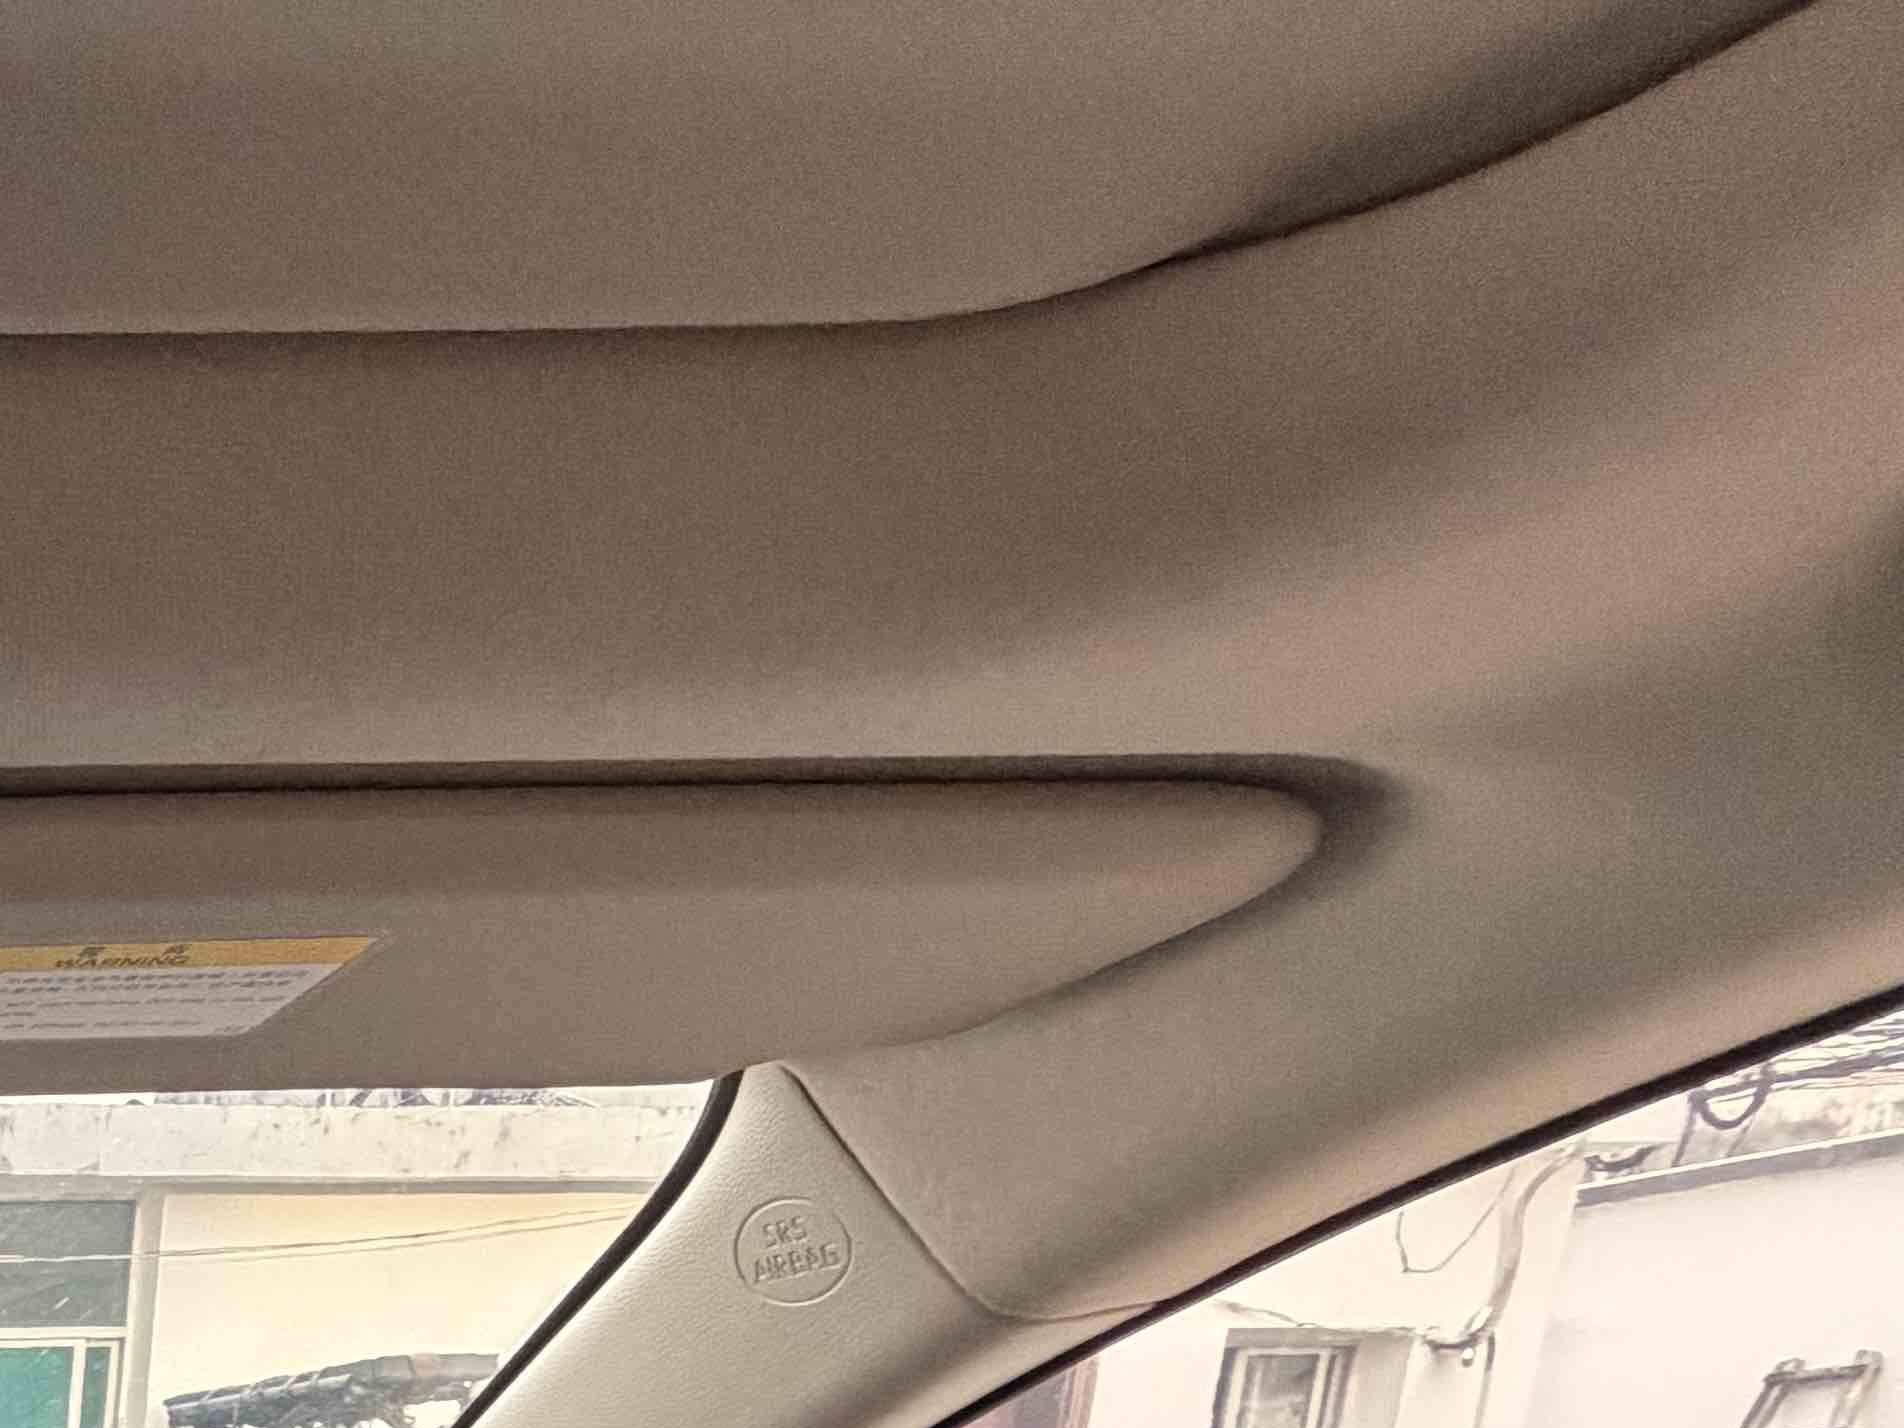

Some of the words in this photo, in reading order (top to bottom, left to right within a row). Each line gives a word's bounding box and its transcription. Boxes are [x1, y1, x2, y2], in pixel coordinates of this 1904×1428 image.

[55, 953, 191, 969] WARNING
[762, 1215, 809, 1250] SRS
[753, 1243, 842, 1284] AIRBAG
